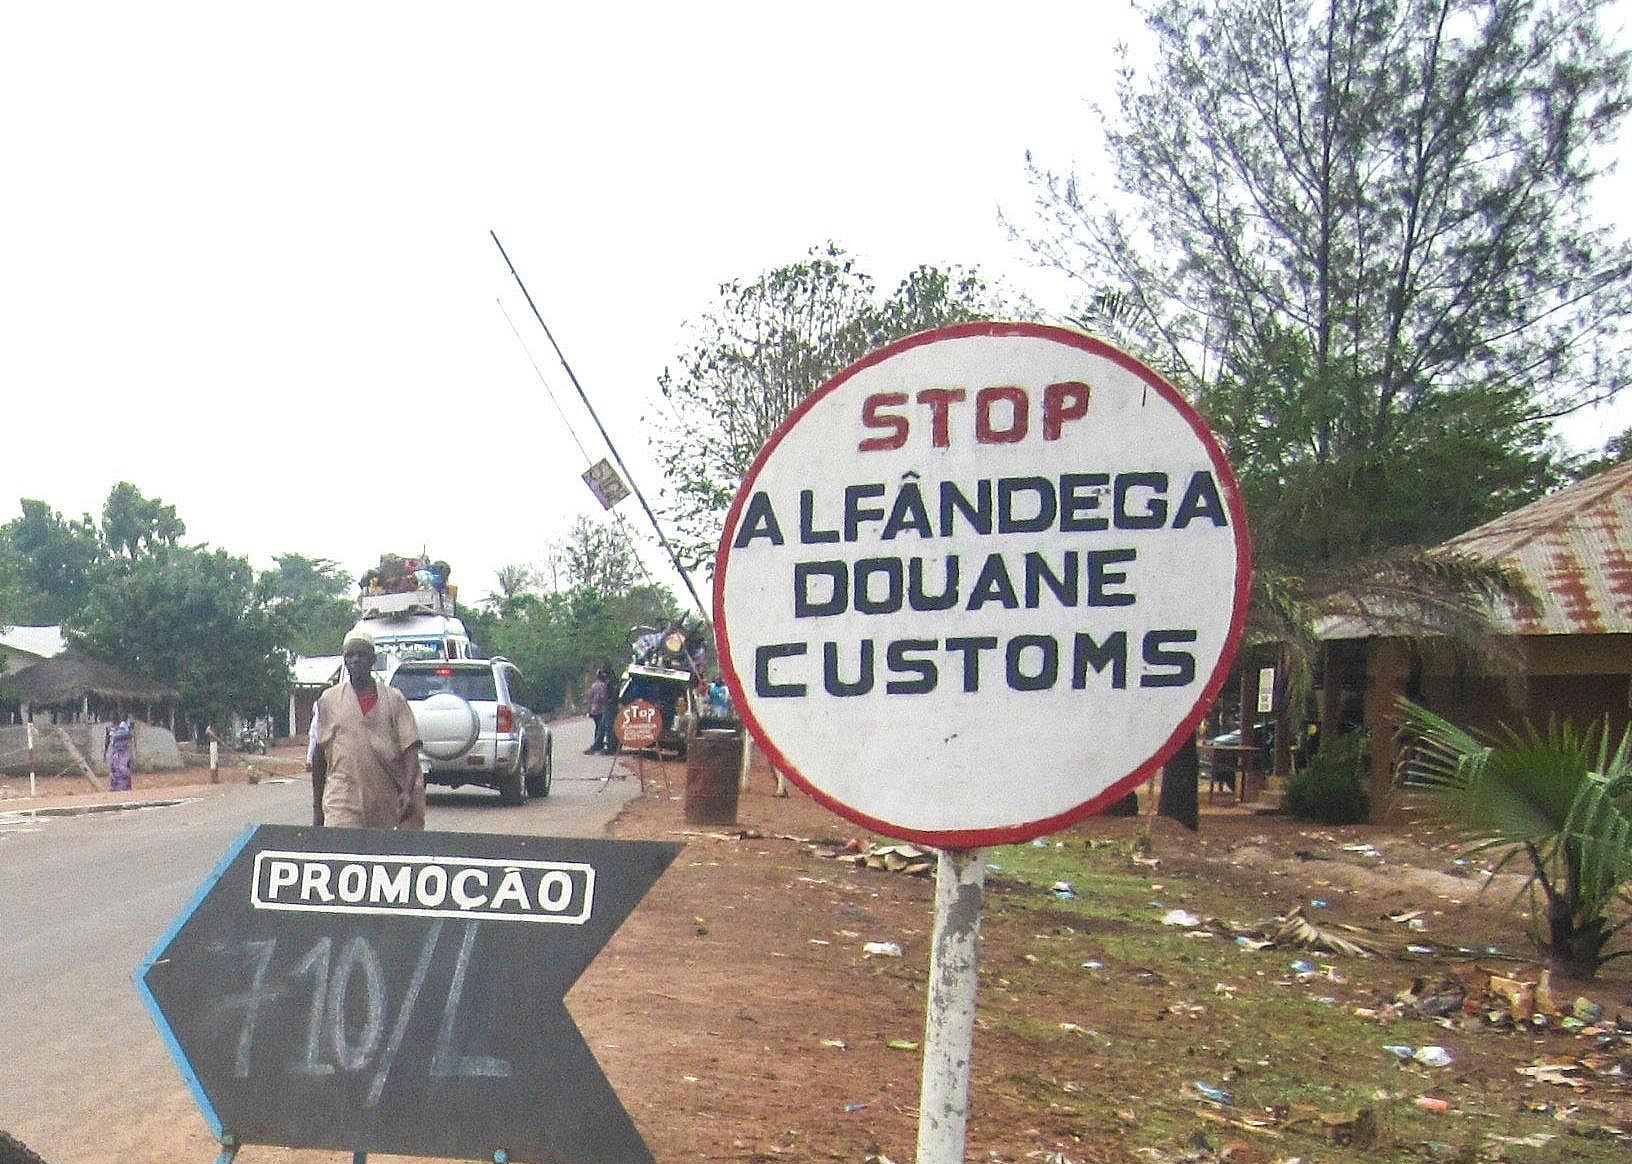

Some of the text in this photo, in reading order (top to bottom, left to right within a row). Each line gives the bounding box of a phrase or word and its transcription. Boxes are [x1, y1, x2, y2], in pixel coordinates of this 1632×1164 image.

[858, 382, 1090, 452] STOP
[734, 470, 1228, 549] ALFÂNDEGA
[794, 548, 1137, 618] DOUANE
[755, 629, 1197, 698] CUSTOMS
[268, 861, 574, 912] PROMOÇÃO
